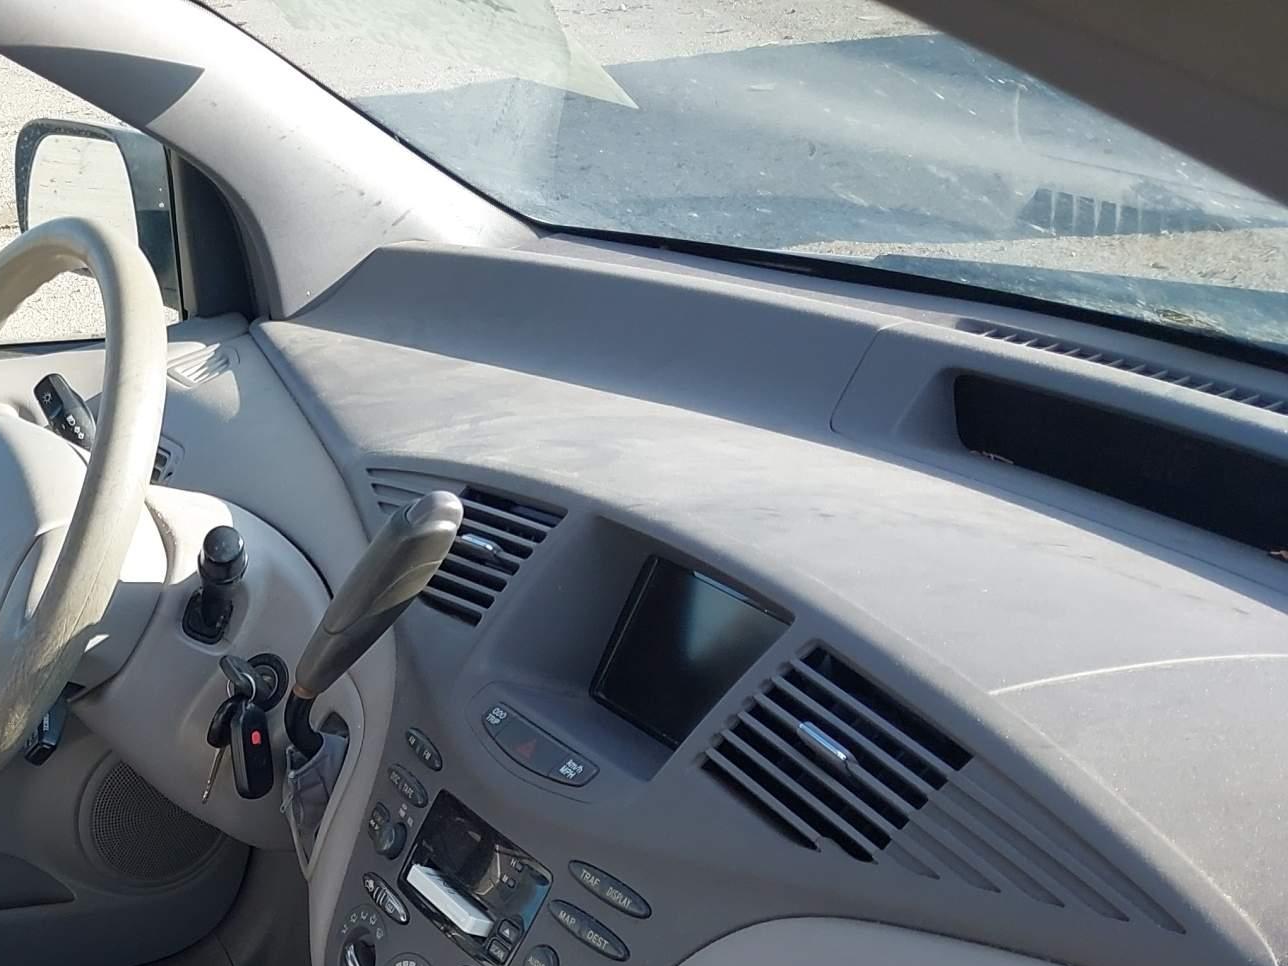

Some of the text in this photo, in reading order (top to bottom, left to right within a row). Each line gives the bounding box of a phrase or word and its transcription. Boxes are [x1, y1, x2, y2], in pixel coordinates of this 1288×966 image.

[559, 764, 577, 779] MPH
[605, 885, 633, 909] DISPLAY
[557, 909, 577, 929] MAP
[585, 929, 609, 951] DEST
